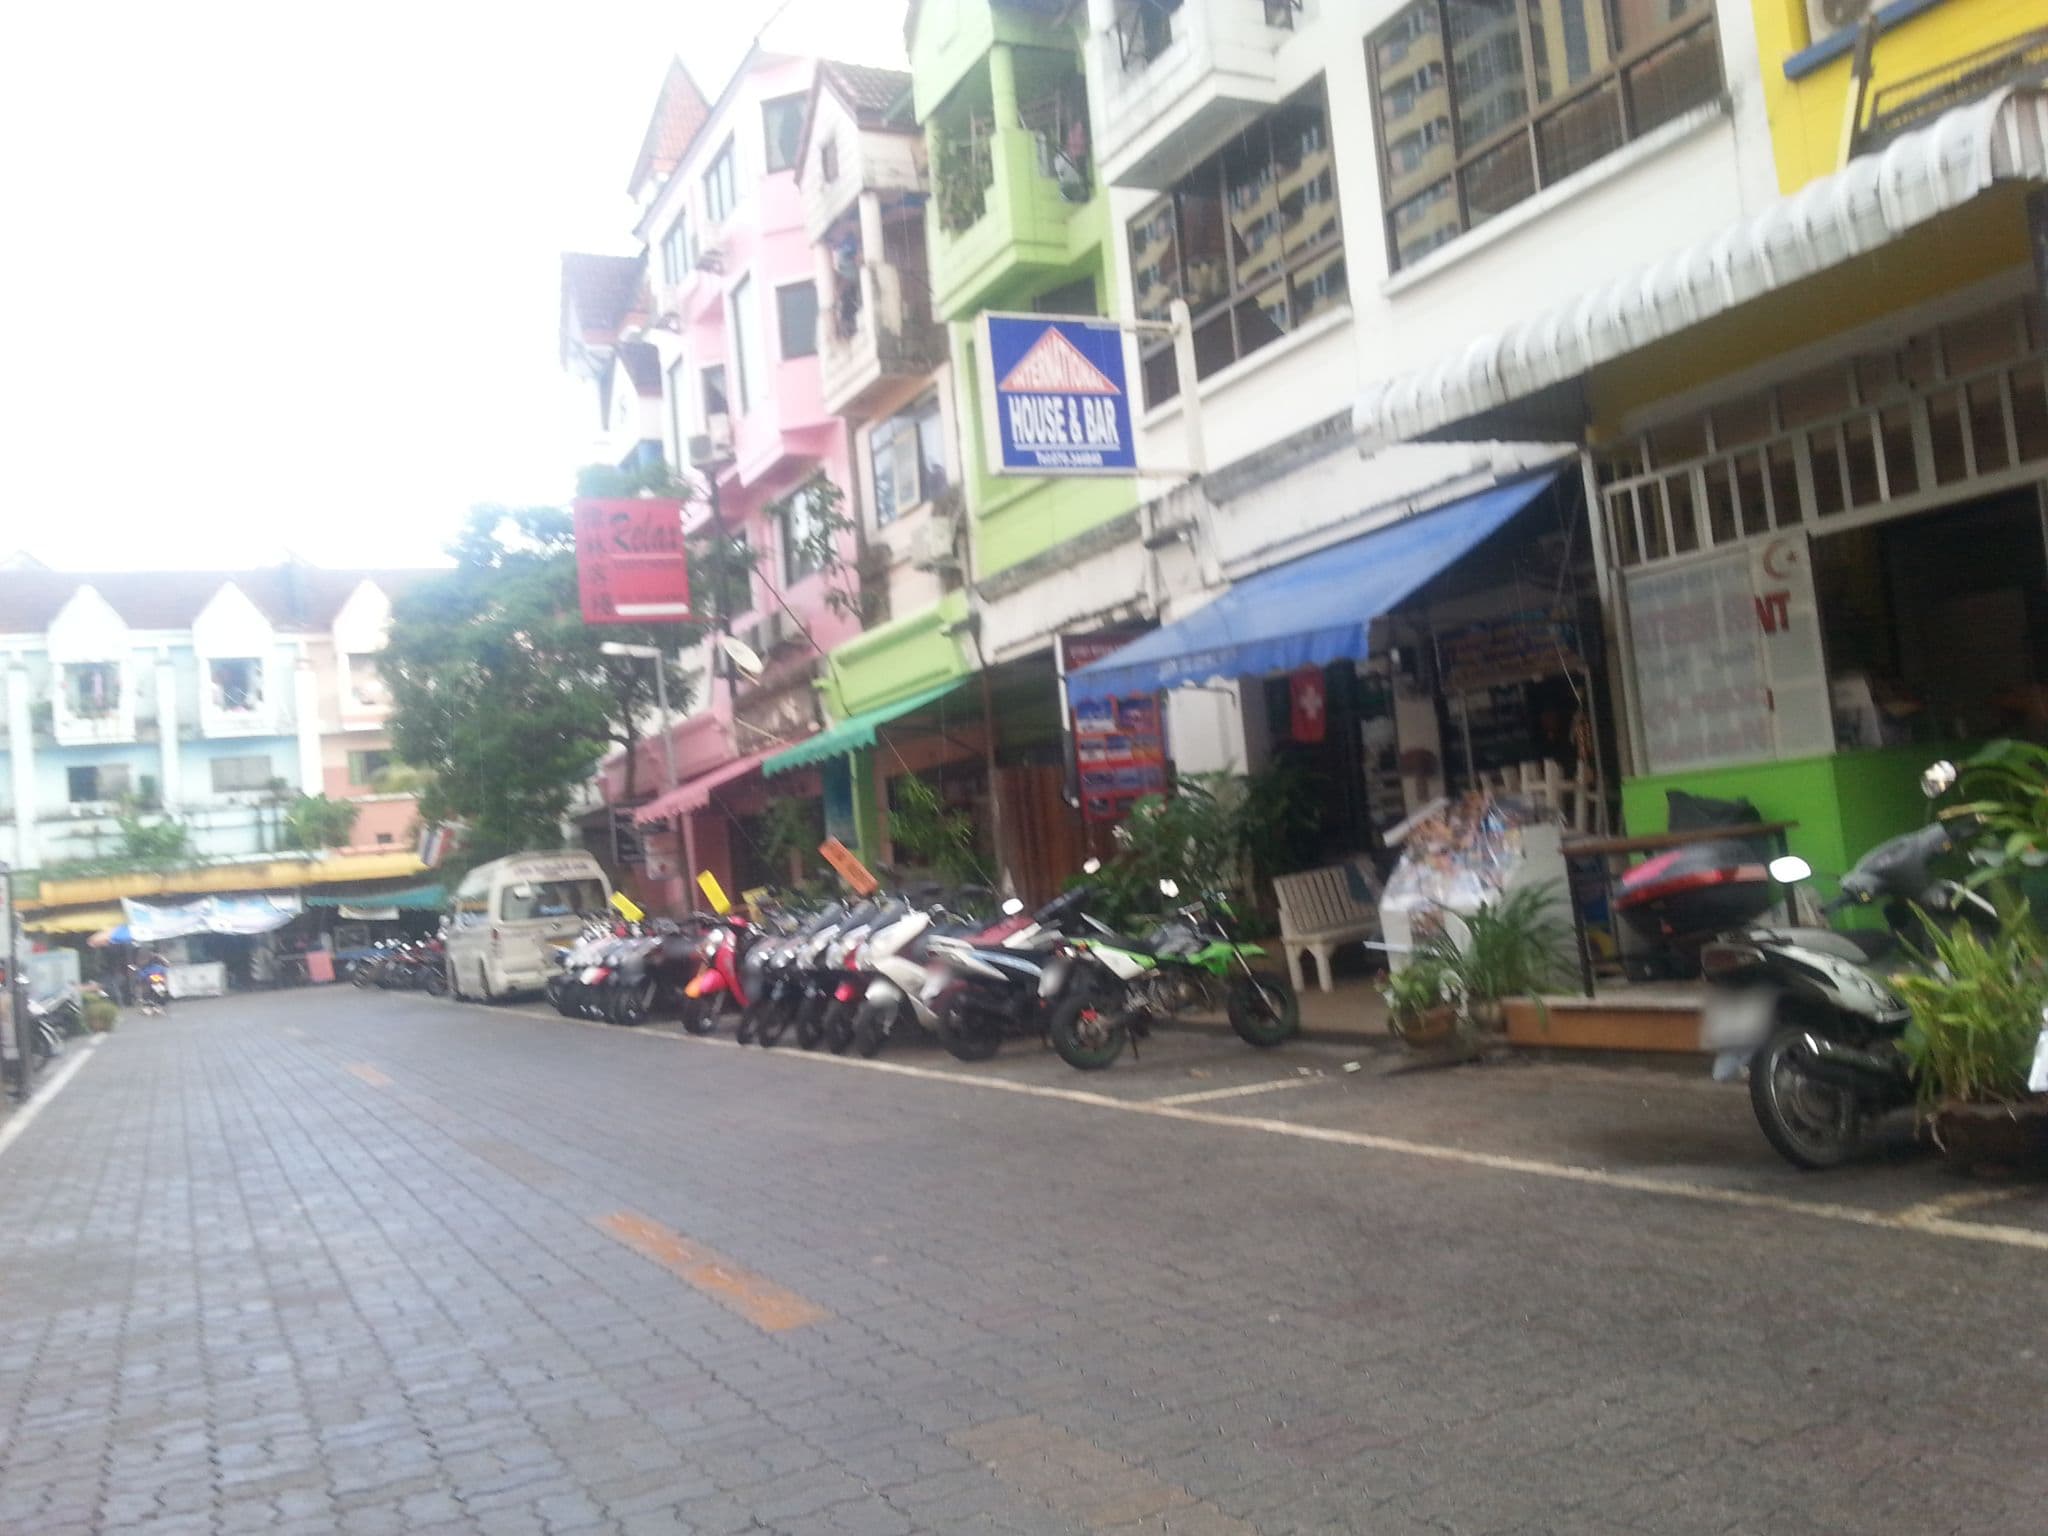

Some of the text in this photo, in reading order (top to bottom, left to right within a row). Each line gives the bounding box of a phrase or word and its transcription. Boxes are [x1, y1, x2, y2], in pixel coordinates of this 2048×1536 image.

[1008, 395, 1120, 444] HOUSE & BAR
